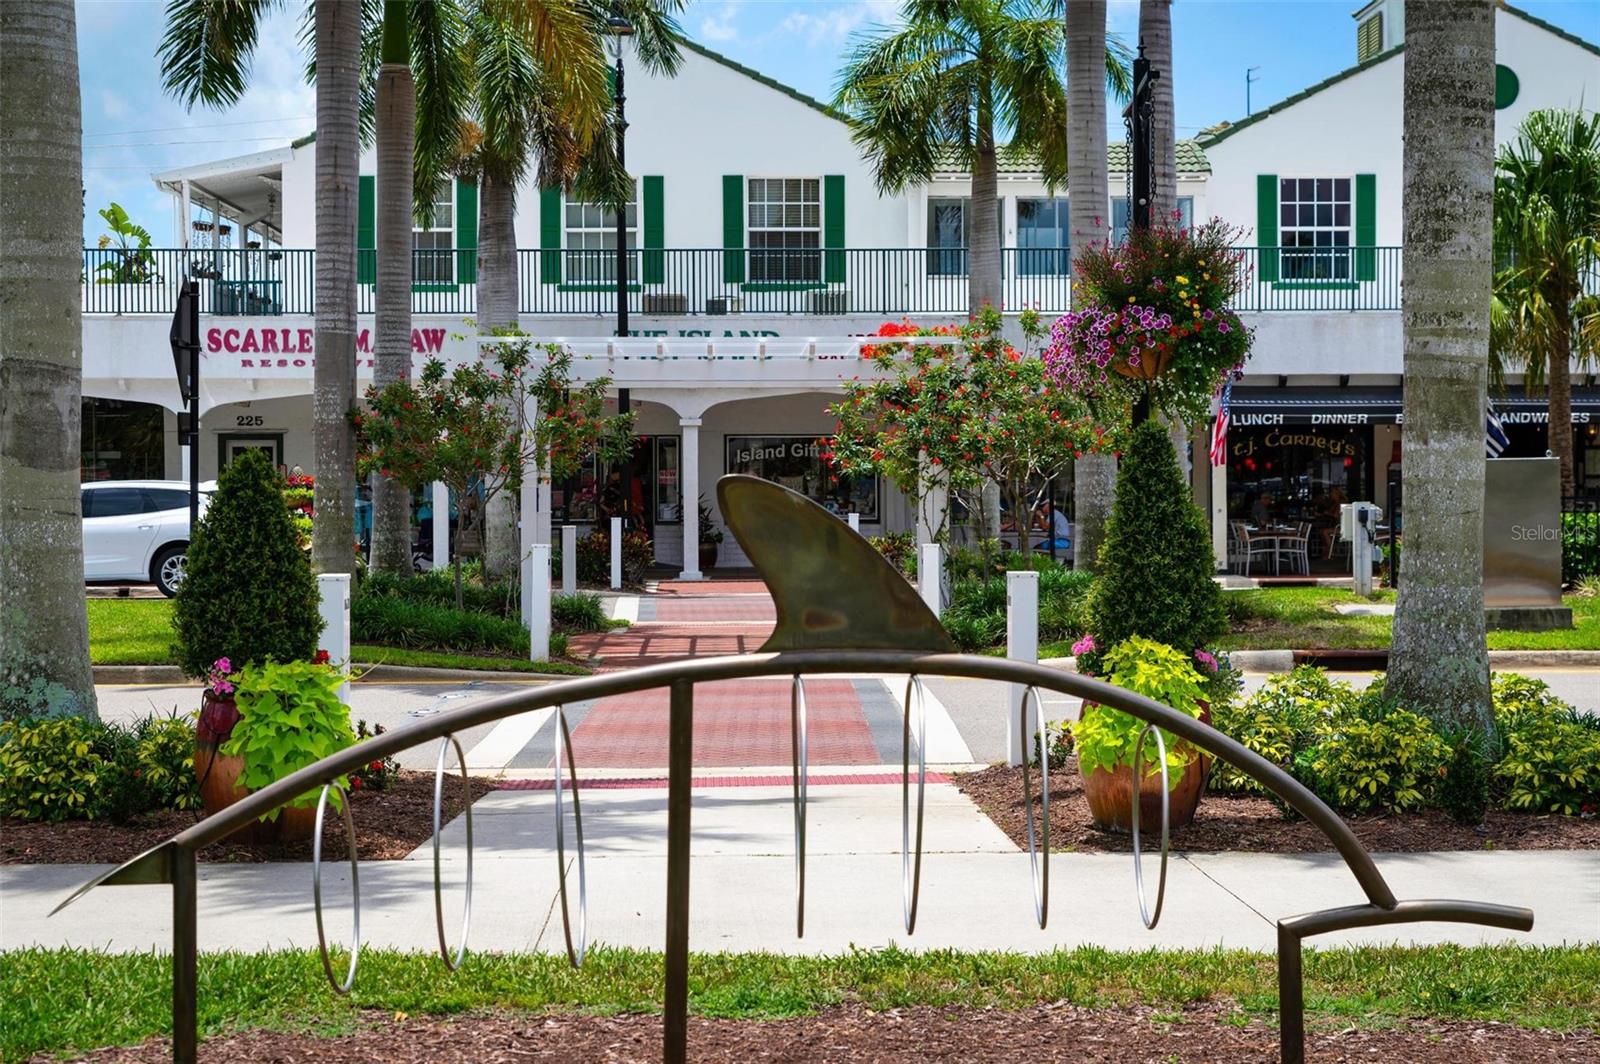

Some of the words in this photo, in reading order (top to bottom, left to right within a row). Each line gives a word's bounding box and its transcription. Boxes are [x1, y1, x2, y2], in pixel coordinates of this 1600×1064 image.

[207, 328, 313, 353] SCARLE
[241, 359, 316, 368] RESO
[236, 415, 264, 427] 225
[1232, 413, 1284, 426] LUNCH
[1311, 413, 1369, 425] DINNER
[736, 444, 786, 463] Island
